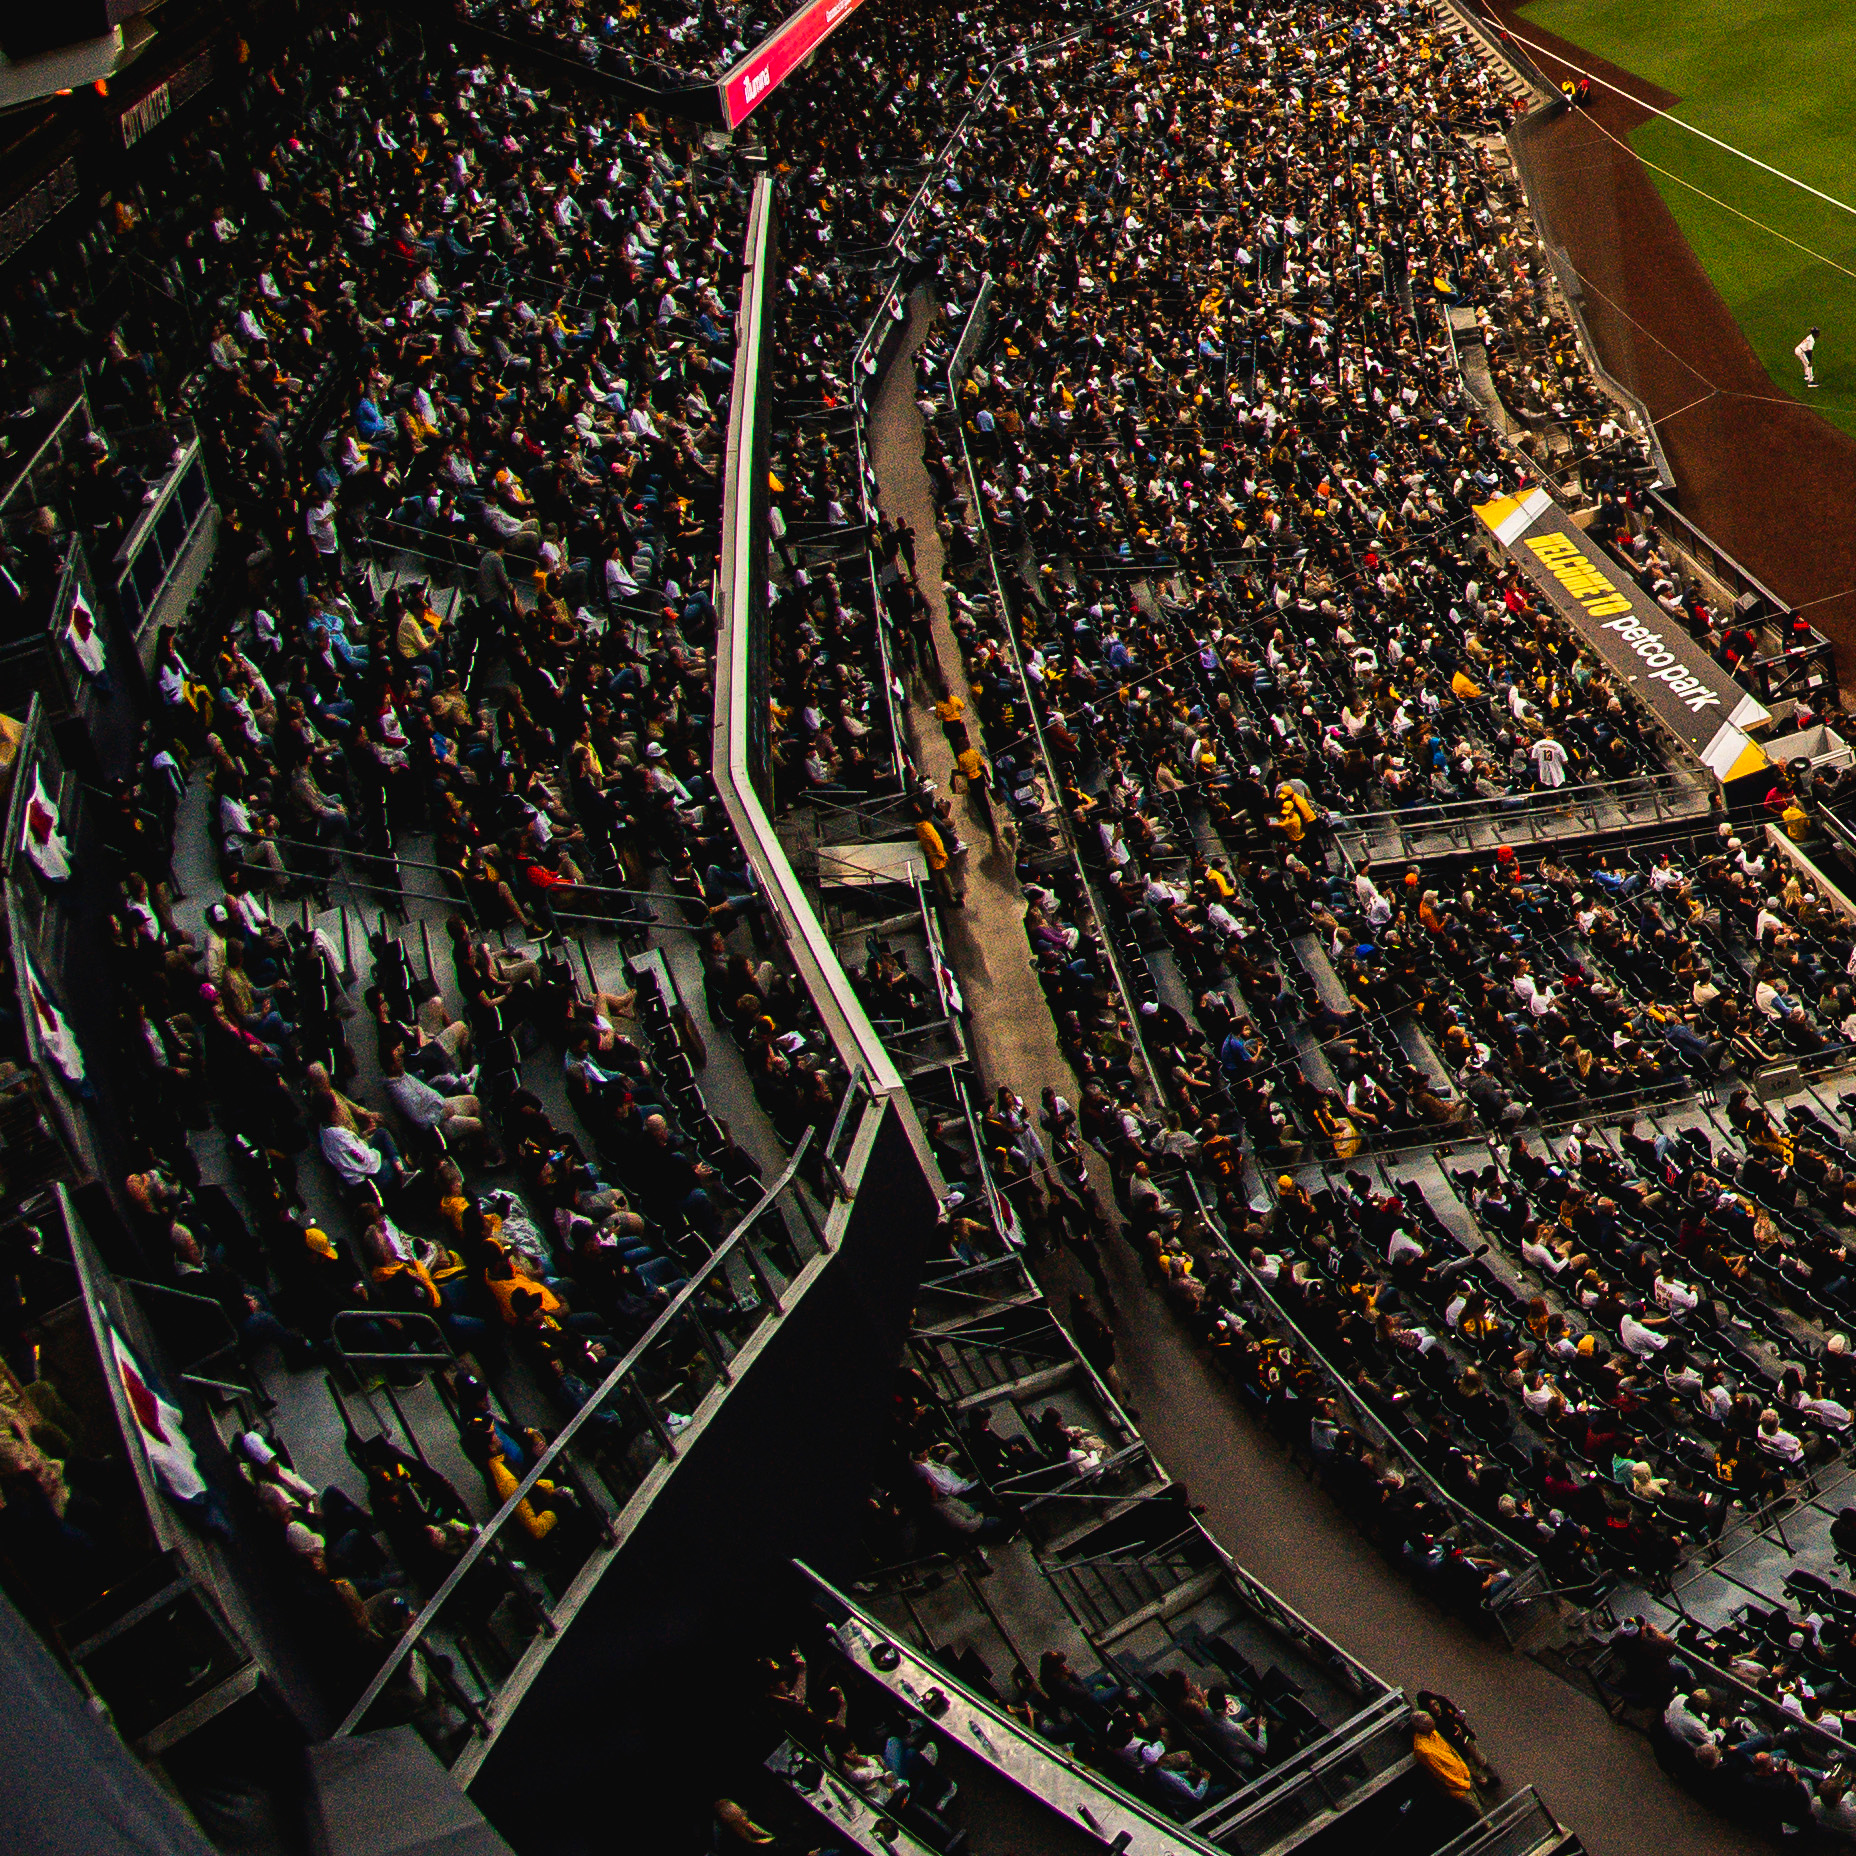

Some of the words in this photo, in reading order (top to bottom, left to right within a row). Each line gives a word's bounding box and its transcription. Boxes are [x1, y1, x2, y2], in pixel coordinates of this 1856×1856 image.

[1524, 532, 1616, 599] WELCOME
[1580, 592, 1633, 617] TO
[1600, 615, 1675, 667] petco
[1648, 664, 1720, 712] park
